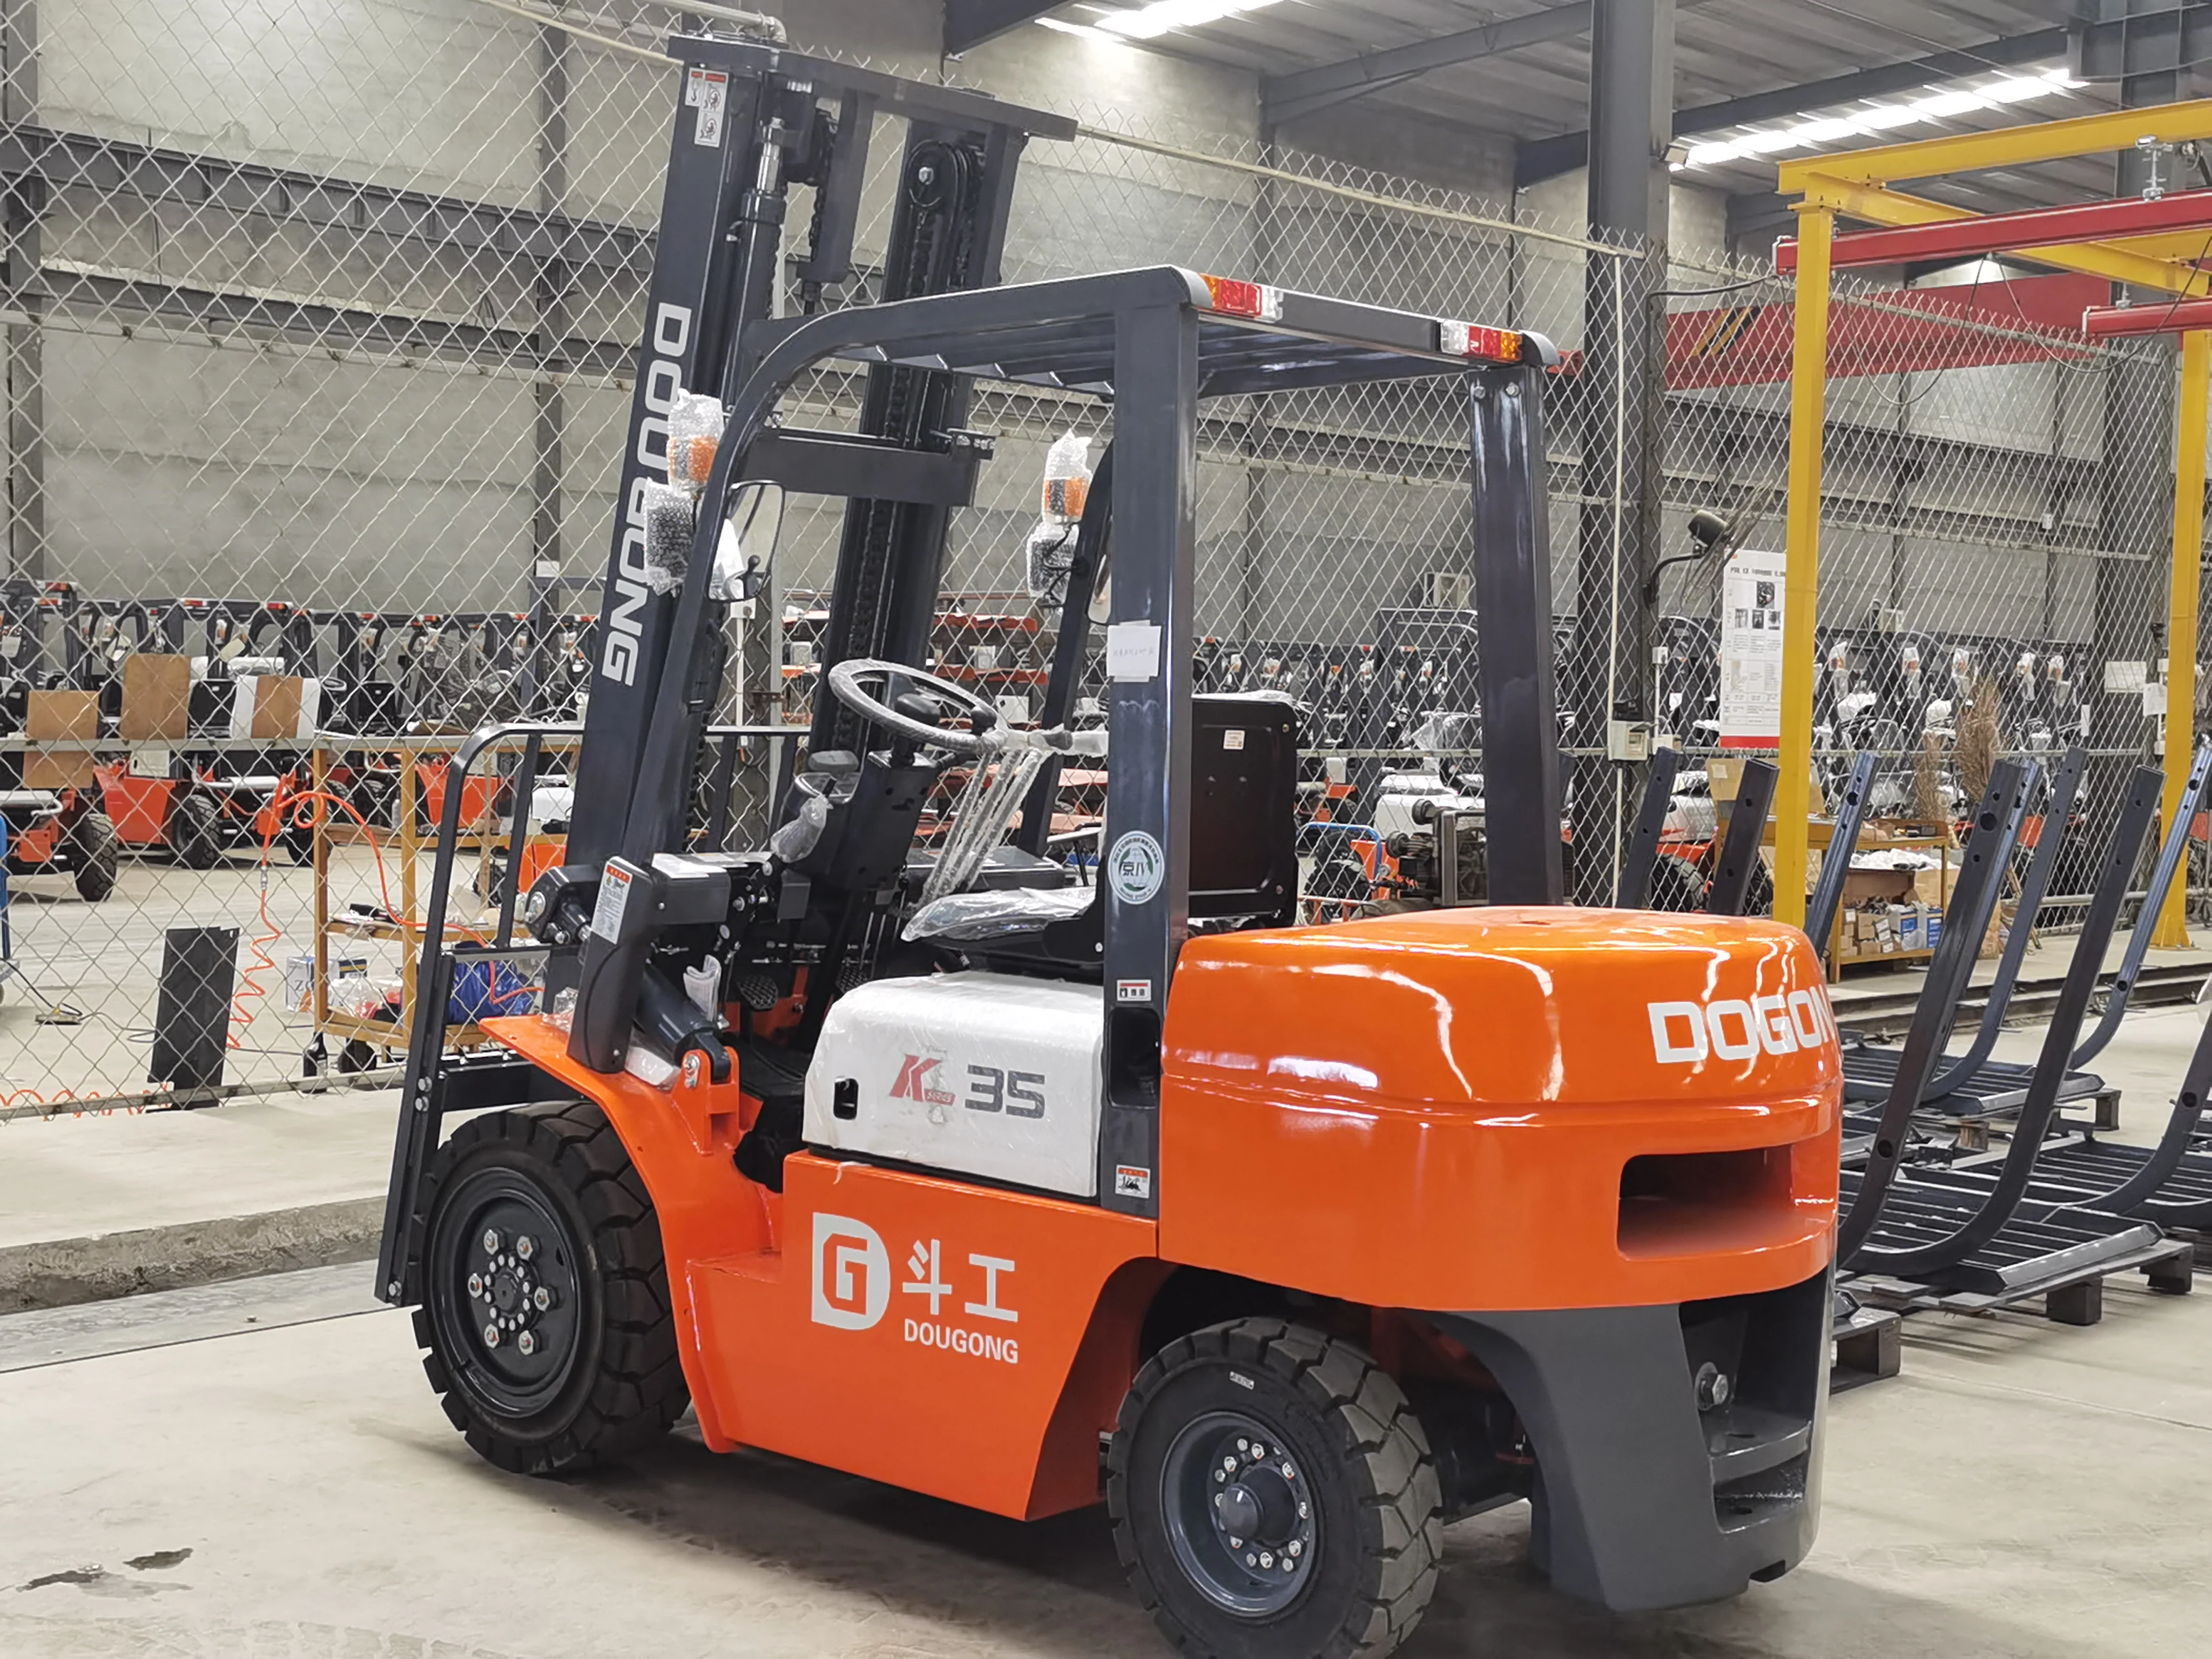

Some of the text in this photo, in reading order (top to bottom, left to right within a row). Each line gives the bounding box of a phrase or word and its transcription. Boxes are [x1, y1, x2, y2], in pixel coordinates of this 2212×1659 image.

[965, 1064, 1046, 1119] 35
[902, 1239, 1019, 1323] 斗工
[904, 1319, 1018, 1364] DOUGONG
